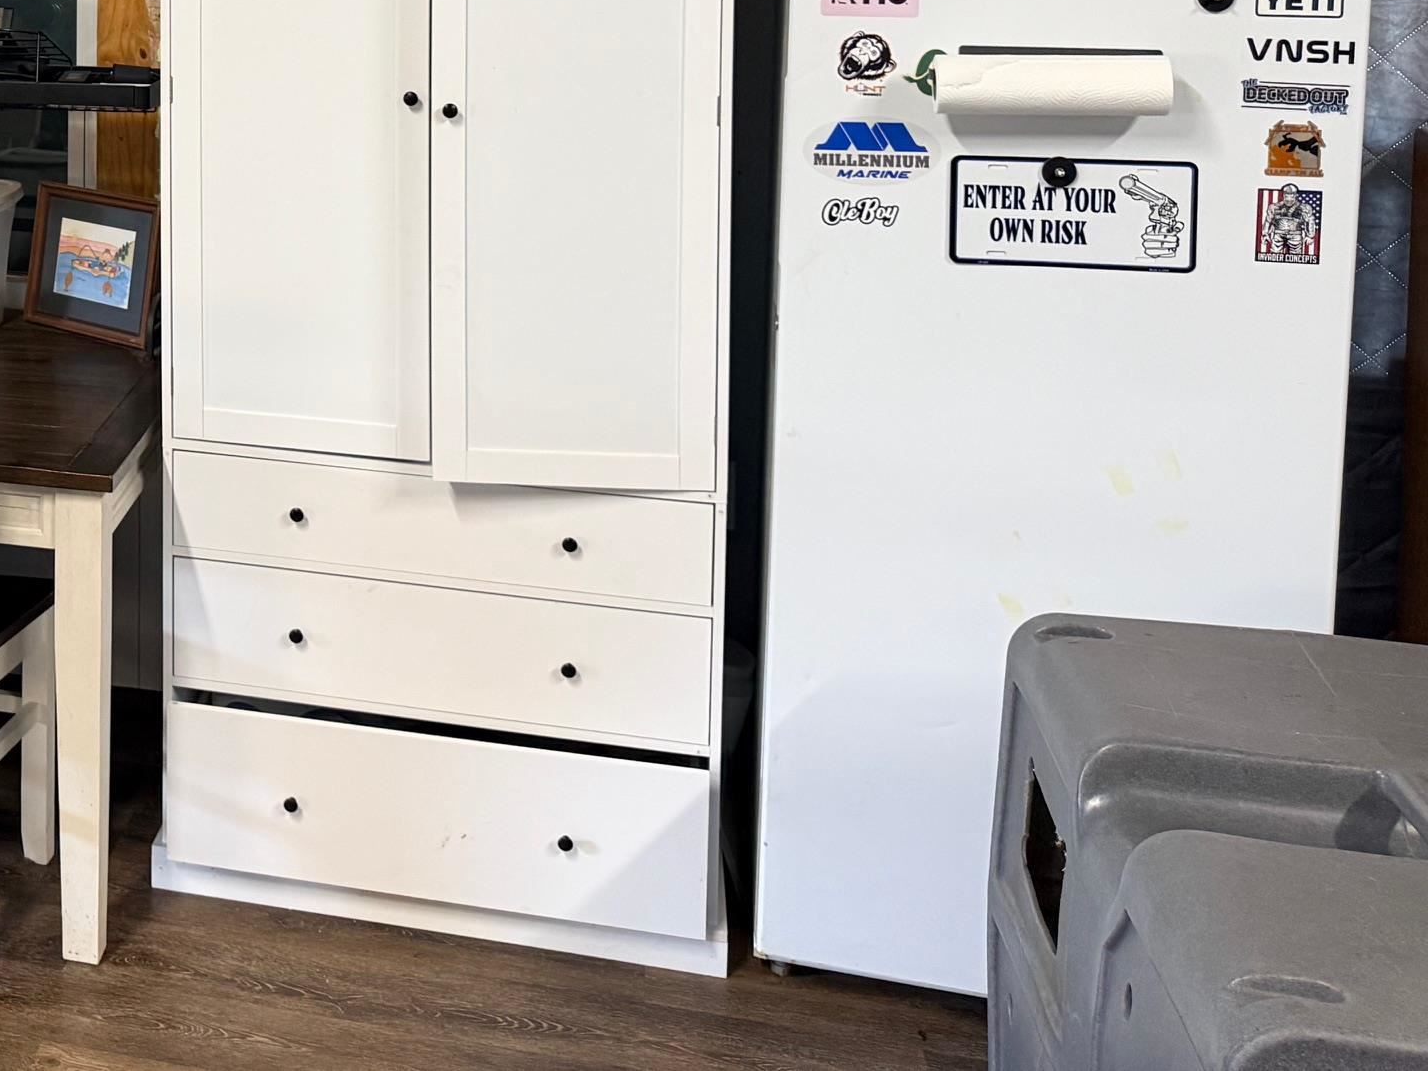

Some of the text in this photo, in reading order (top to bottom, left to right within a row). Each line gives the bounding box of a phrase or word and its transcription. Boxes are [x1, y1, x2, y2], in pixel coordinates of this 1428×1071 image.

[1247, 37, 1356, 65] VNSH
[1243, 86, 1349, 106] DECKED OUT
[813, 152, 930, 168] MILLENNIUM
[837, 169, 912, 179] MARINE
[963, 182, 1117, 213] ENTER AT YOUR
[989, 217, 1087, 245] OWN RISK
[1285, 254, 1317, 264] CONCEPTS
